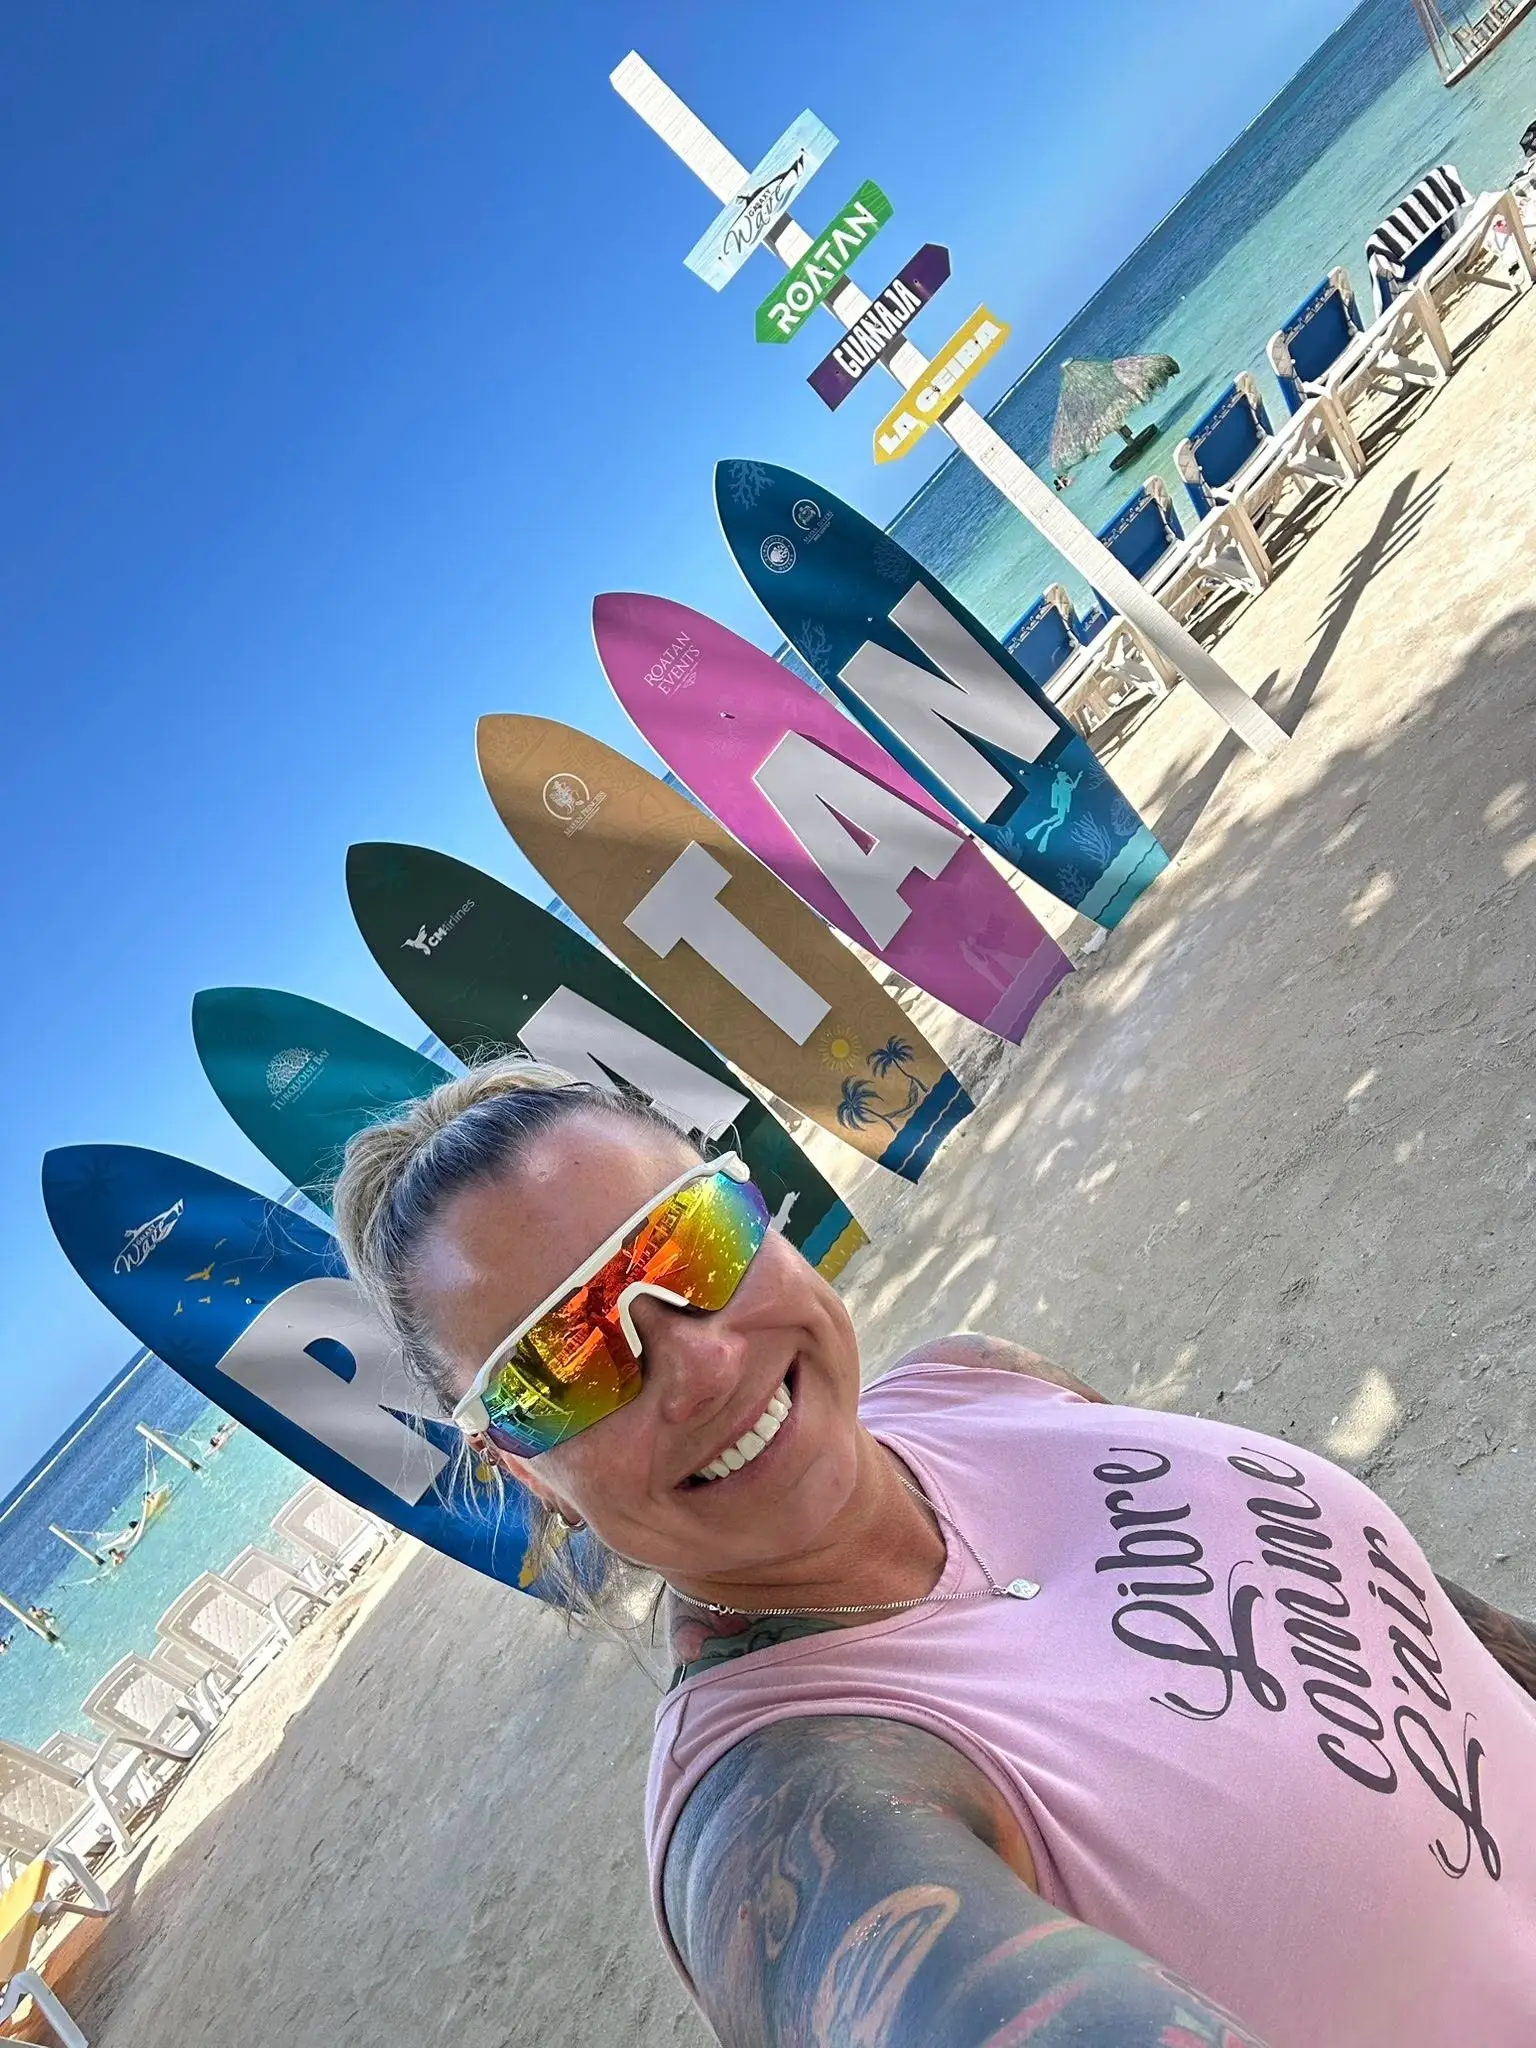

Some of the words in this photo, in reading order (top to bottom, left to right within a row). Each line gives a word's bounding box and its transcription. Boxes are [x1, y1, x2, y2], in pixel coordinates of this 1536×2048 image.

[723, 184, 785, 255] Wave
[748, 188, 772, 217] GALAXY
[768, 201, 878, 334] ROATAN
[833, 279, 922, 378] GUANAJA
[877, 411, 919, 455] LA
[915, 320, 1002, 413] CEIBA
[643, 631, 691, 687] ROATAN
[657, 645, 701, 695] EVENTS
[838, 580, 1061, 824] N
[752, 730, 965, 951] A
[623, 840, 832, 1046] T
[270, 1061, 318, 1111] TURQUOISE
[312, 1047, 330, 1066] BAY
[114, 1219, 165, 1274] Wave
[1093, 1447, 1287, 1721] Libre
[1227, 1446, 1398, 1794] comme
